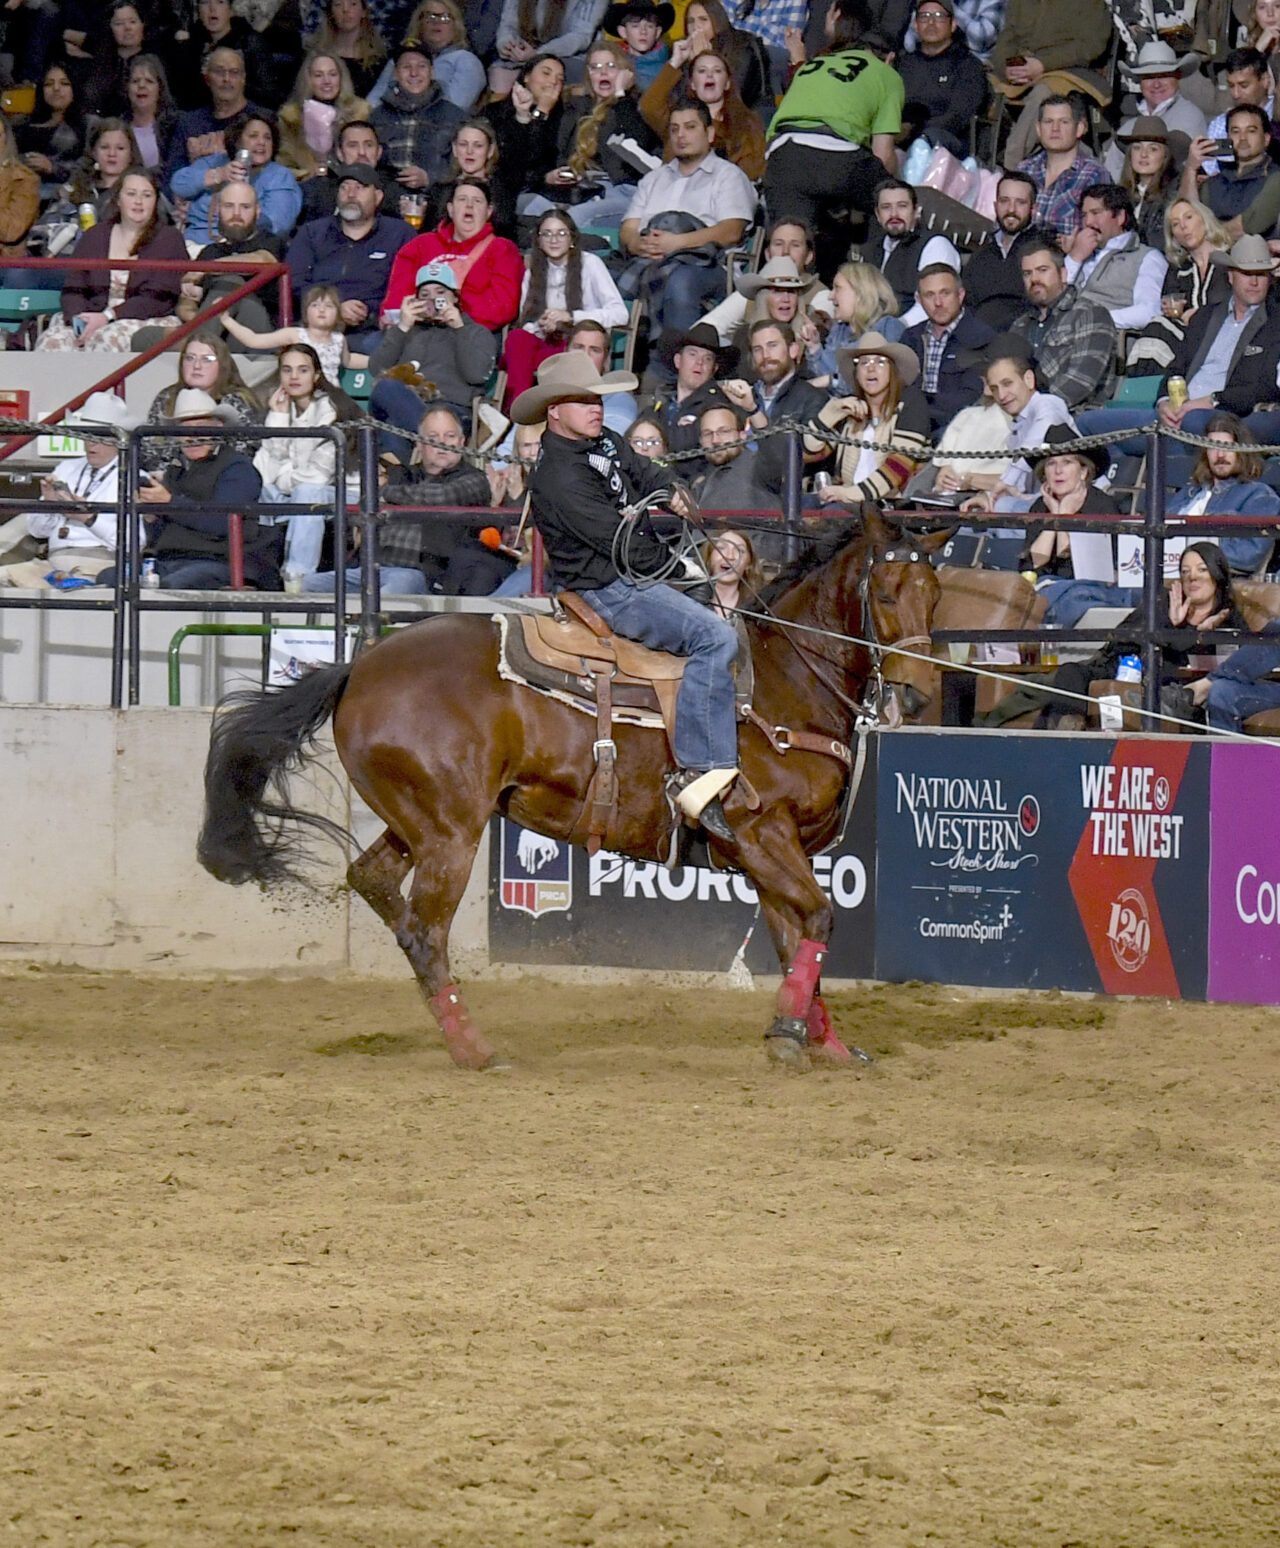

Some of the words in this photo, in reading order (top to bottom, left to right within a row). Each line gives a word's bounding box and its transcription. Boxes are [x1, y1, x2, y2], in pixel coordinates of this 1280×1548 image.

[19, 297, 30, 311] 5
[353, 373, 365, 388] 9
[1107, 463, 1118, 479] 6
[943, 541, 954, 557] 6
[894, 772, 1008, 813] NATIONAL
[1081, 765, 1116, 809] WE
[1118, 766, 1154, 810] ARE
[912, 811, 1020, 852] WESTERN
[1090, 812, 1129, 856] THE
[1131, 813, 1184, 859] WEST
[589, 850, 867, 909] PROREO
[920, 917, 1003, 944] CommonSpirit
[1106, 902, 1151, 956] 120
